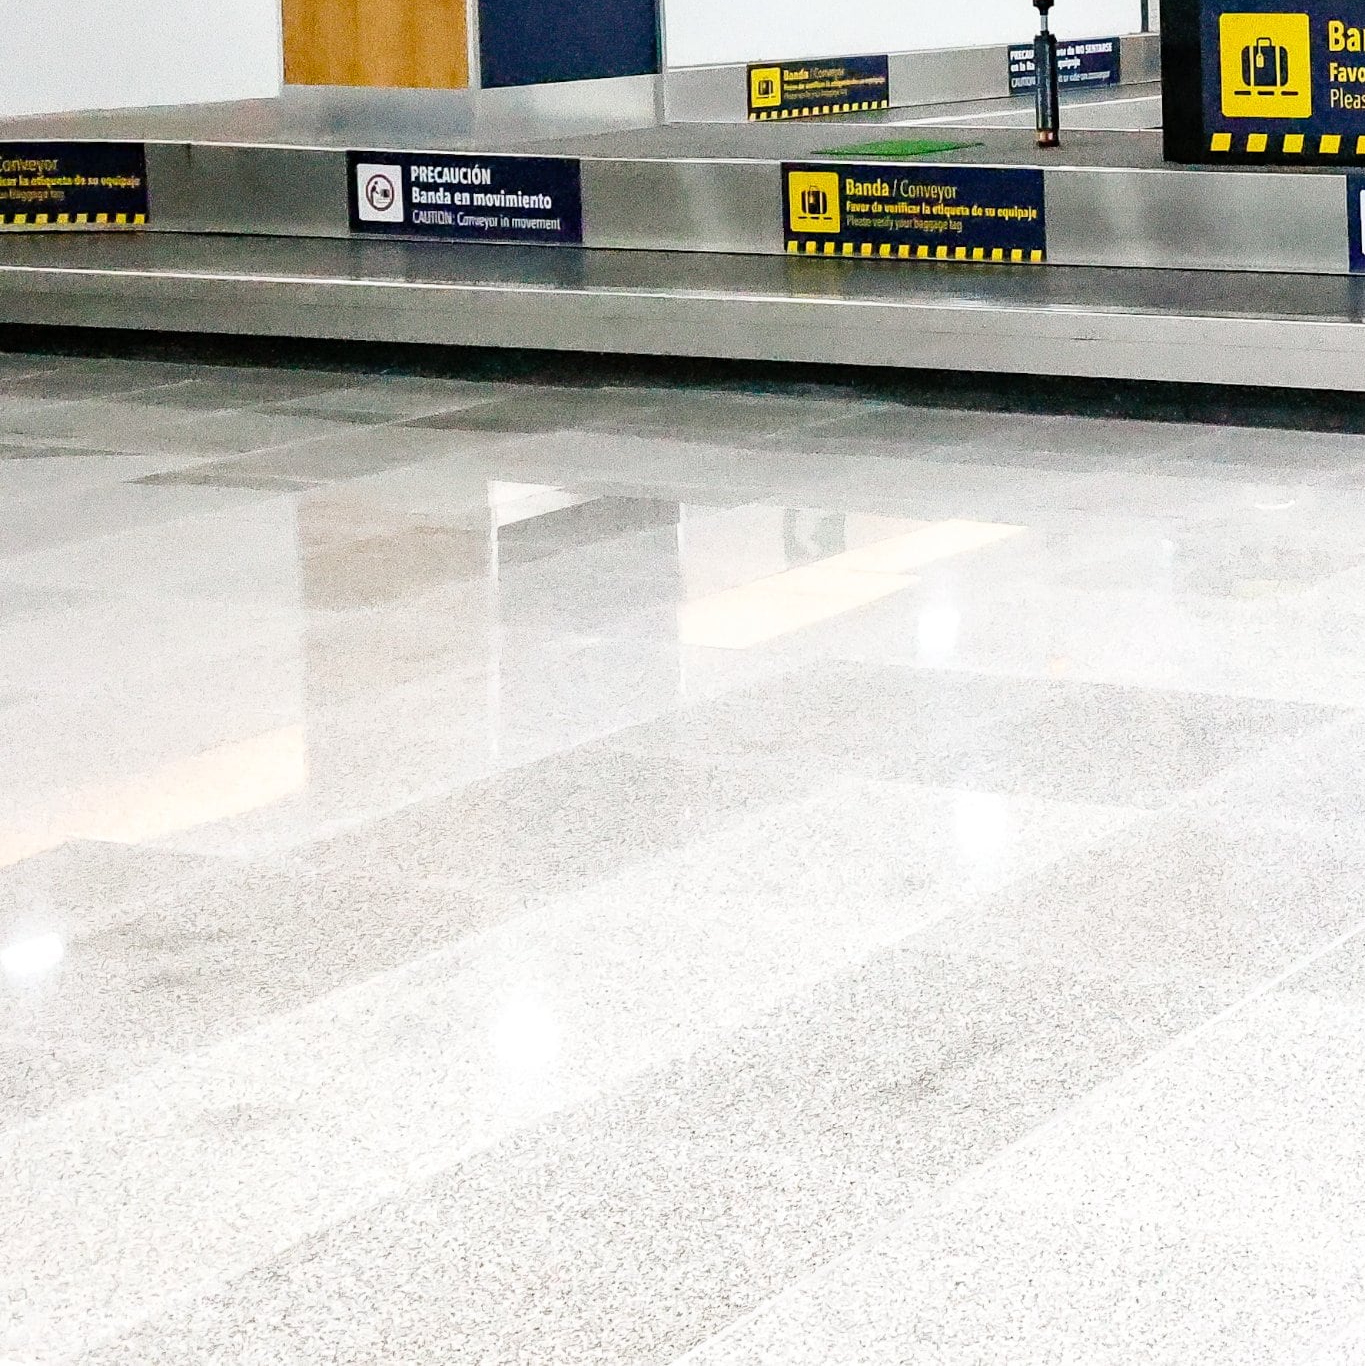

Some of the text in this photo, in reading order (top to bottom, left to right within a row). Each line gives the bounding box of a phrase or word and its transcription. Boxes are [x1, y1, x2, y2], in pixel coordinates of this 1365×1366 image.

[1010, 50, 1034, 61] PRECAU
[0, 156, 58, 175] onveyor
[410, 164, 491, 185] PRECAUCIÓN
[412, 187, 552, 209] Banda en movimiento
[845, 178, 957, 203] Banda / Conveyor
[412, 209, 455, 224] CAUTION:
[512, 217, 561, 230] movement
